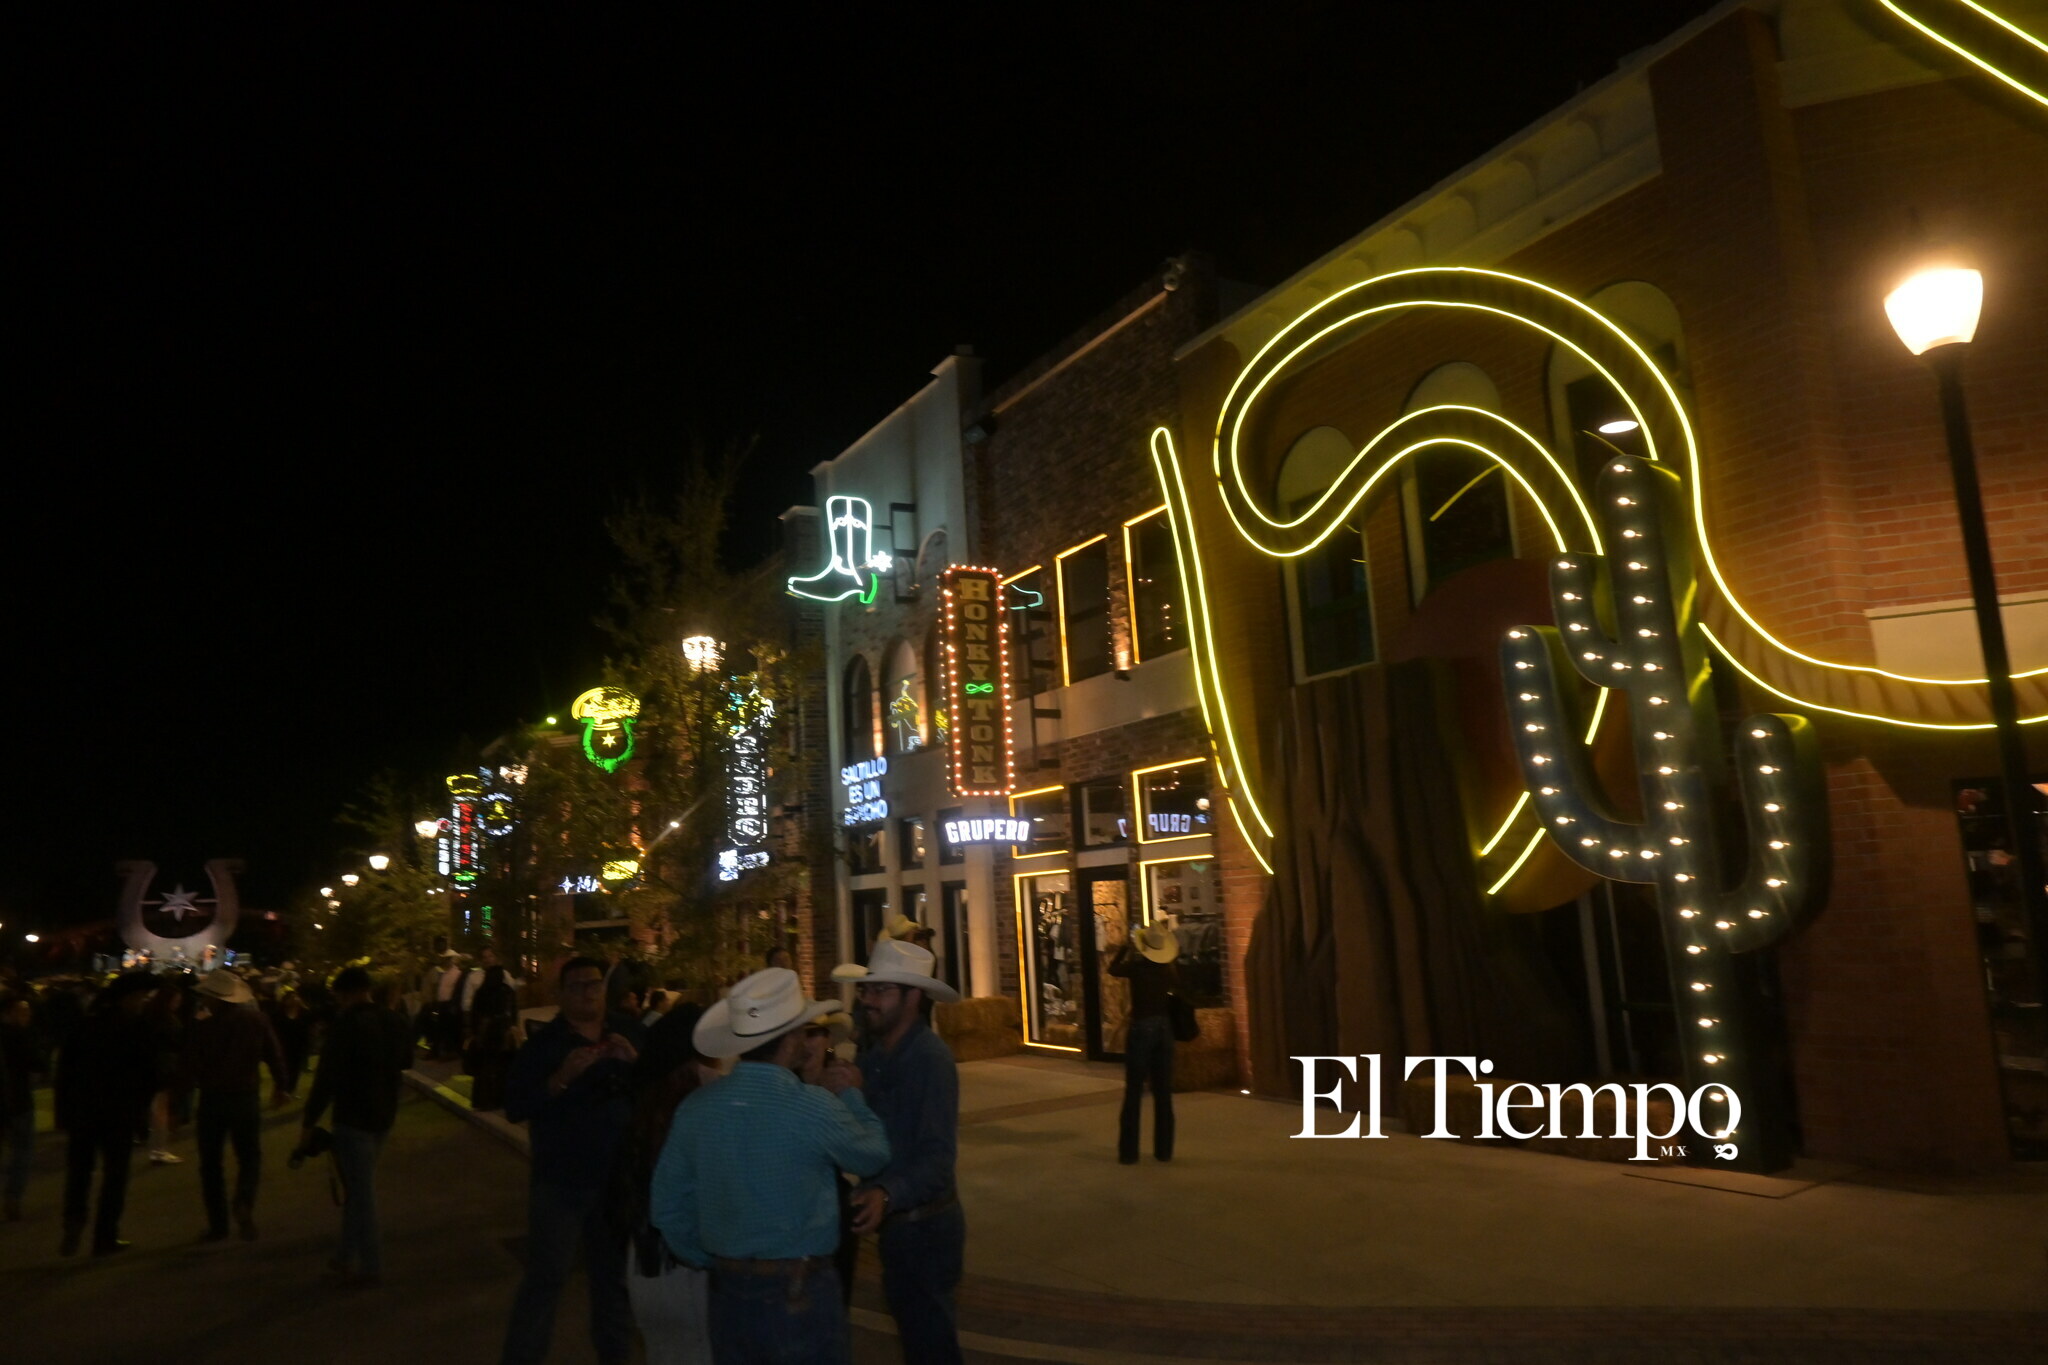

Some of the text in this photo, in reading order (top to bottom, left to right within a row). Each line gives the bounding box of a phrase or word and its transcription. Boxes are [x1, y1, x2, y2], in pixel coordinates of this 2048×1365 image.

[958, 577, 997, 784] HONKY TONK
[944, 818, 1030, 844] GRUPERO
